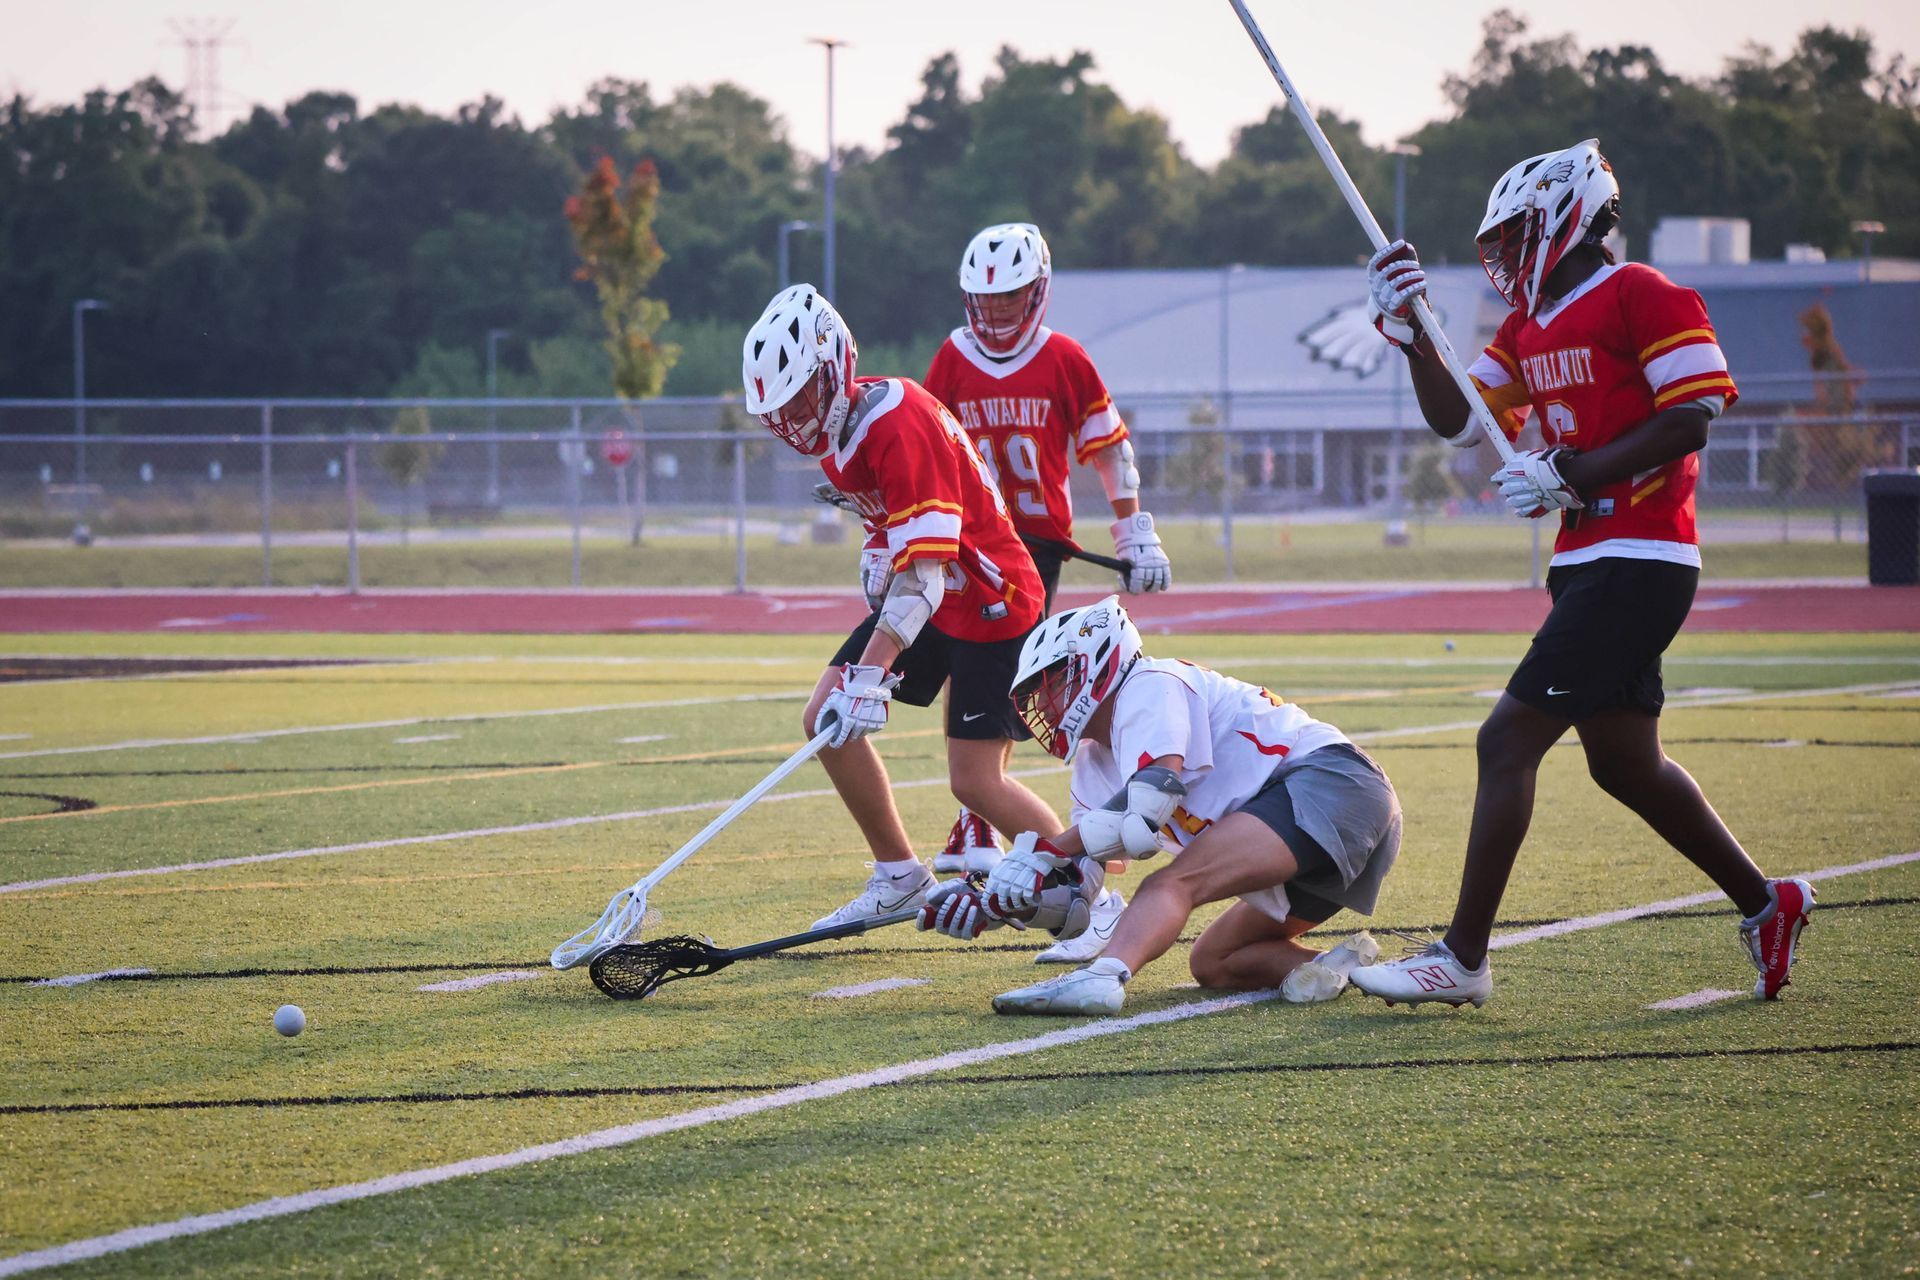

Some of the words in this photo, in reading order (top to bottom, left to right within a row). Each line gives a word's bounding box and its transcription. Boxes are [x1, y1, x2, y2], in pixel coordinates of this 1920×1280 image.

[1529, 347, 1595, 392] WALNUT
[981, 397, 1051, 428] WALNUT
[976, 432, 1050, 518] 19
[1772, 911, 1785, 950] balance
[1768, 950, 1778, 970] new
[1408, 966, 1457, 992] N
